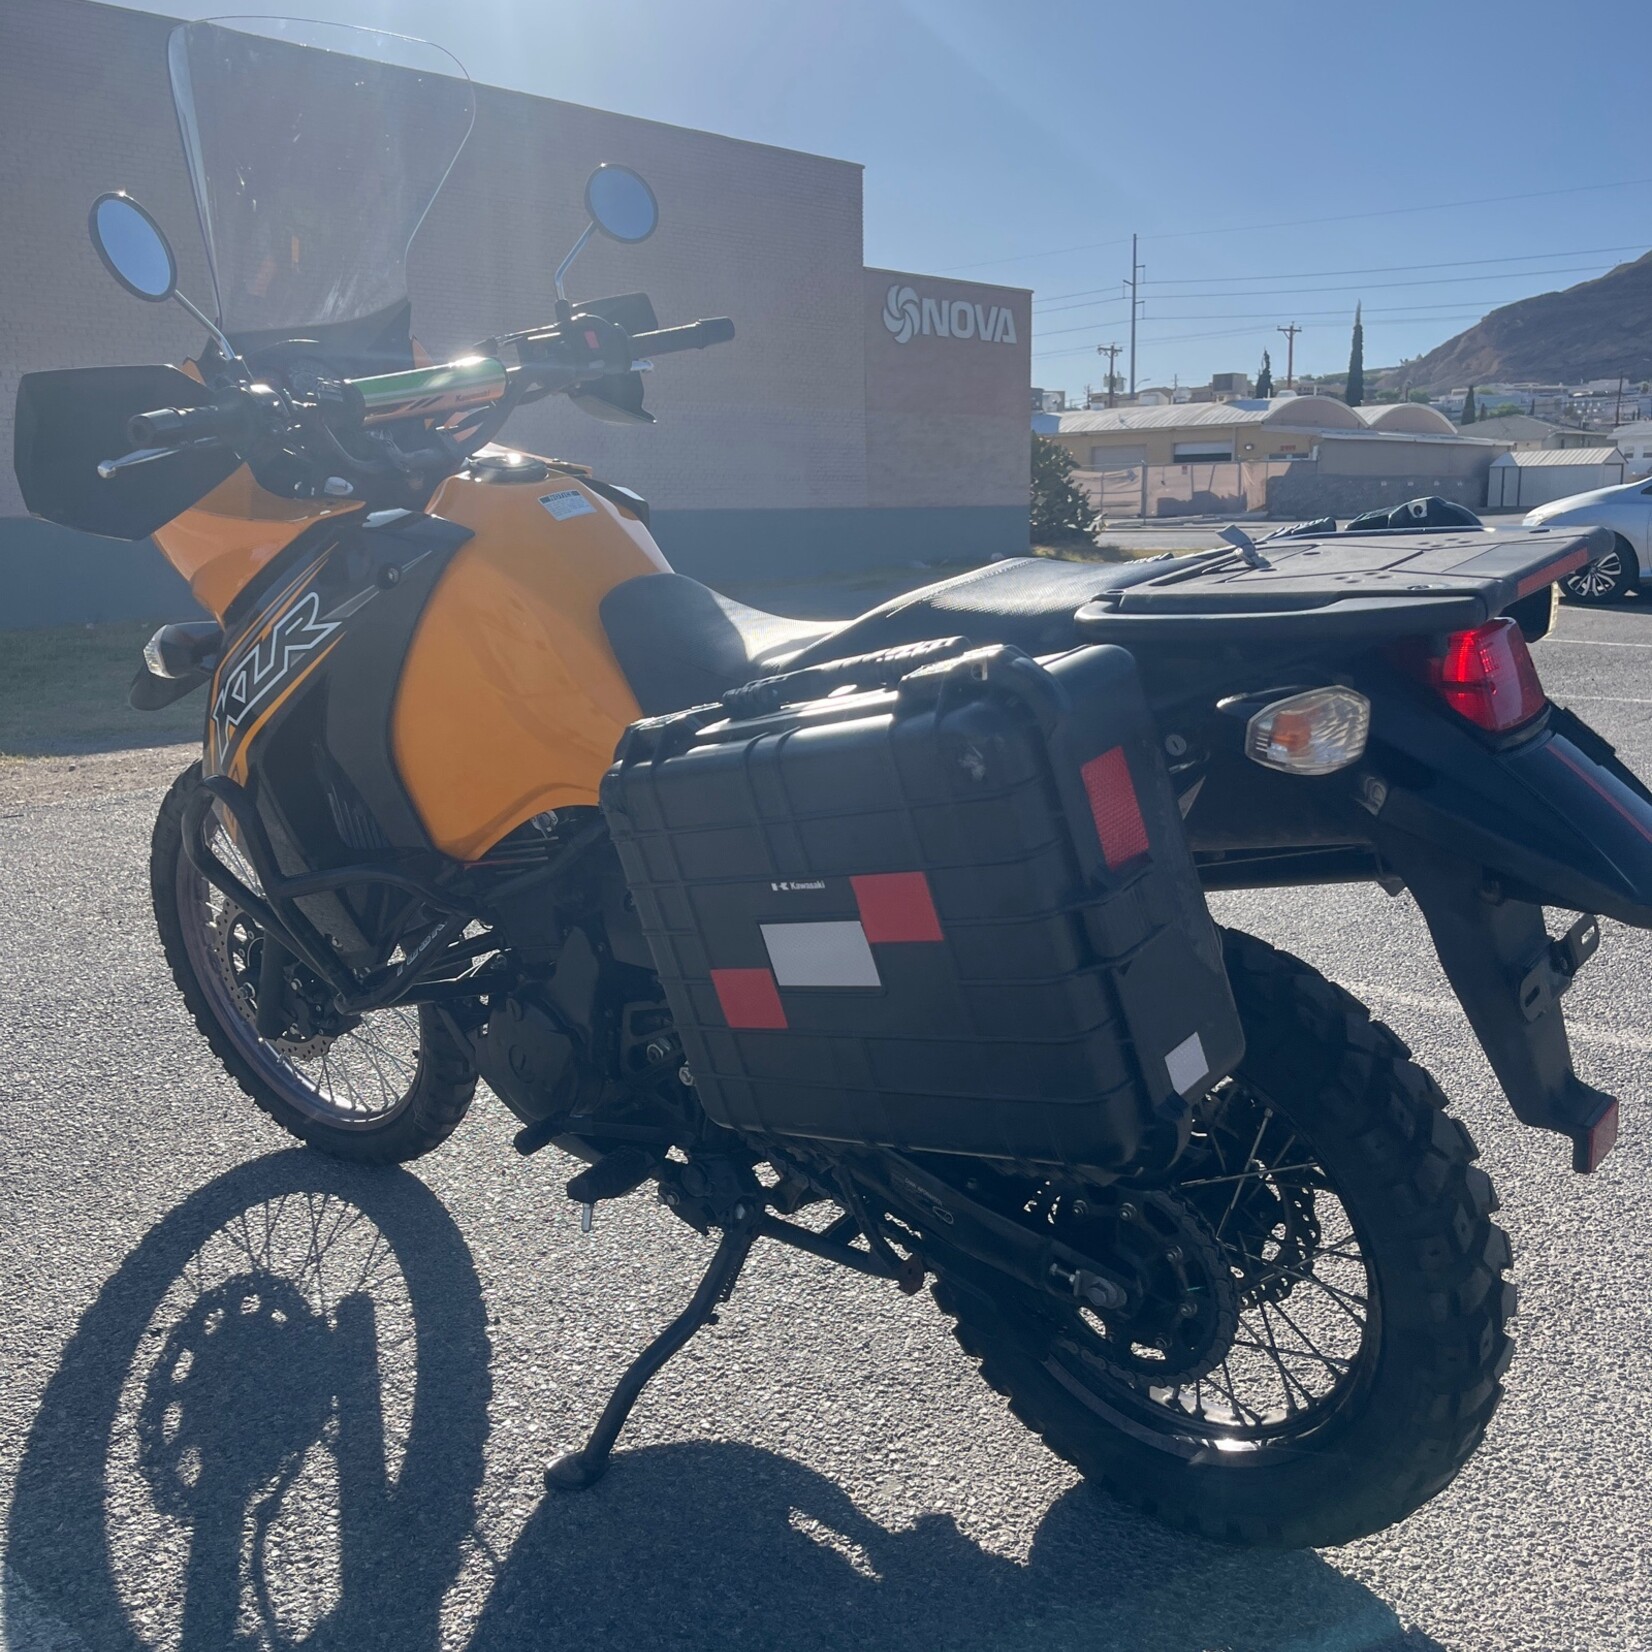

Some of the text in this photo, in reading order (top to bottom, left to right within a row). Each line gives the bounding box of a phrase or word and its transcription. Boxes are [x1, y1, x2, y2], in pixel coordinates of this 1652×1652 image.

[922, 298, 1017, 344] NOVA
[212, 591, 343, 765] KLR
[790, 880, 825, 890] Kawasaki
